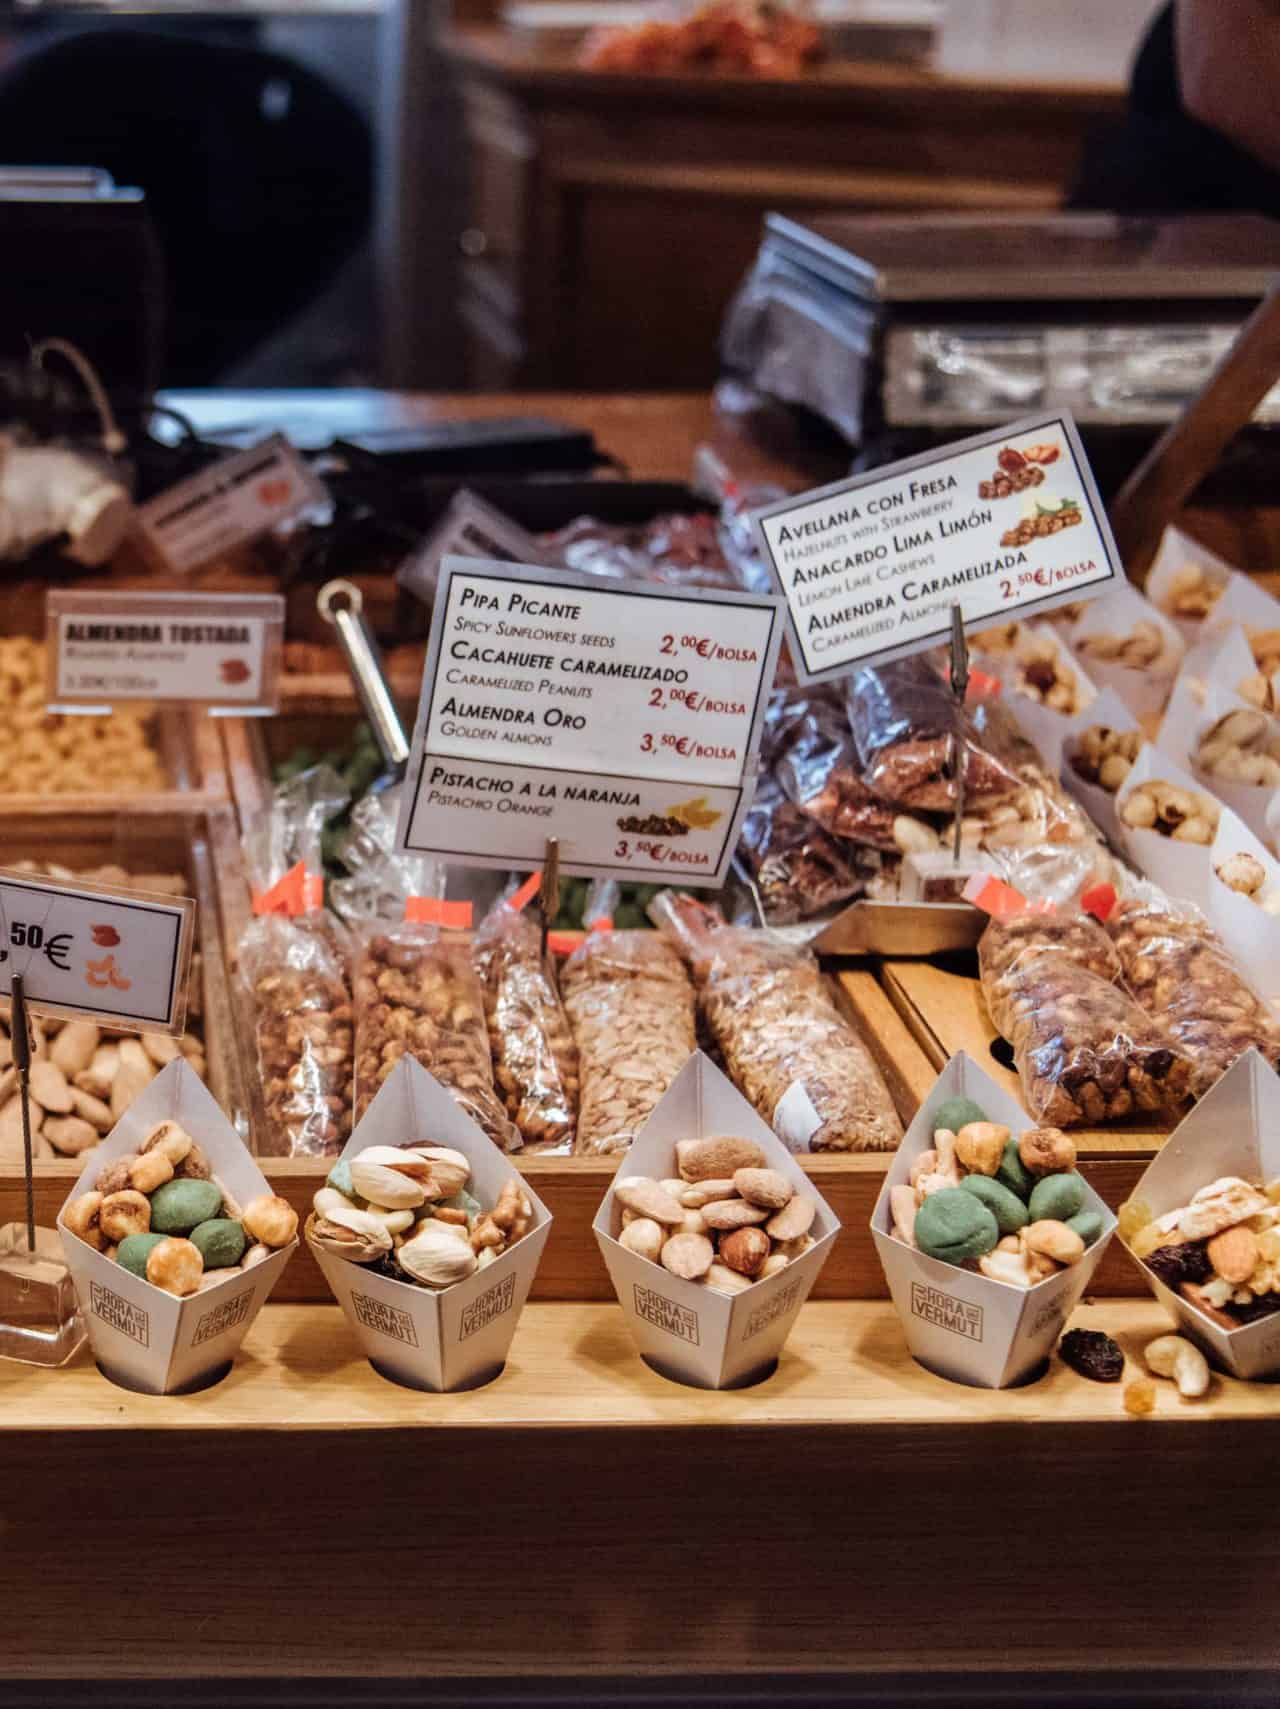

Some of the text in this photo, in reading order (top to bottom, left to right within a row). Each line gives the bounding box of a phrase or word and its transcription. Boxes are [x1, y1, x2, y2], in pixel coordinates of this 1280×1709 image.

[778, 475, 958, 544] AVELLANA CON FRESA
[881, 499, 954, 532] STRAWBERRY
[792, 509, 993, 587] ANACARDO LIMA LIMÓN
[459, 588, 582, 620] PIPA PICANTE
[808, 552, 1027, 634] ALMENDRA CARAMELIZADA
[66, 624, 250, 644] ALMENDRA TOSTADA
[454, 616, 616, 649] SPICY SUNFLOWERS SEEDS
[811, 617, 895, 653] CARAMELIZED
[450, 640, 689, 684] CACAHUETE CARAMELIZADO
[446, 668, 593, 699] CARAMELIZED PEANUTS
[440, 697, 586, 730] ALMENDRA ORO
[440, 720, 553, 747] GOLDEN ALMONS
[426, 790, 554, 817] PISTACHIO ORANGE
[429, 767, 640, 807] PISTACHO A LA NARANJA
[103, 1290, 134, 1317] HORA
[638, 1300, 695, 1340] VERMUT
[649, 1294, 682, 1319] HORA
[914, 1300, 979, 1336] VERMUT
[927, 1292, 964, 1315] HORA
[95, 1301, 145, 1341] VERMUT
[360, 1309, 413, 1341] VERMUT
